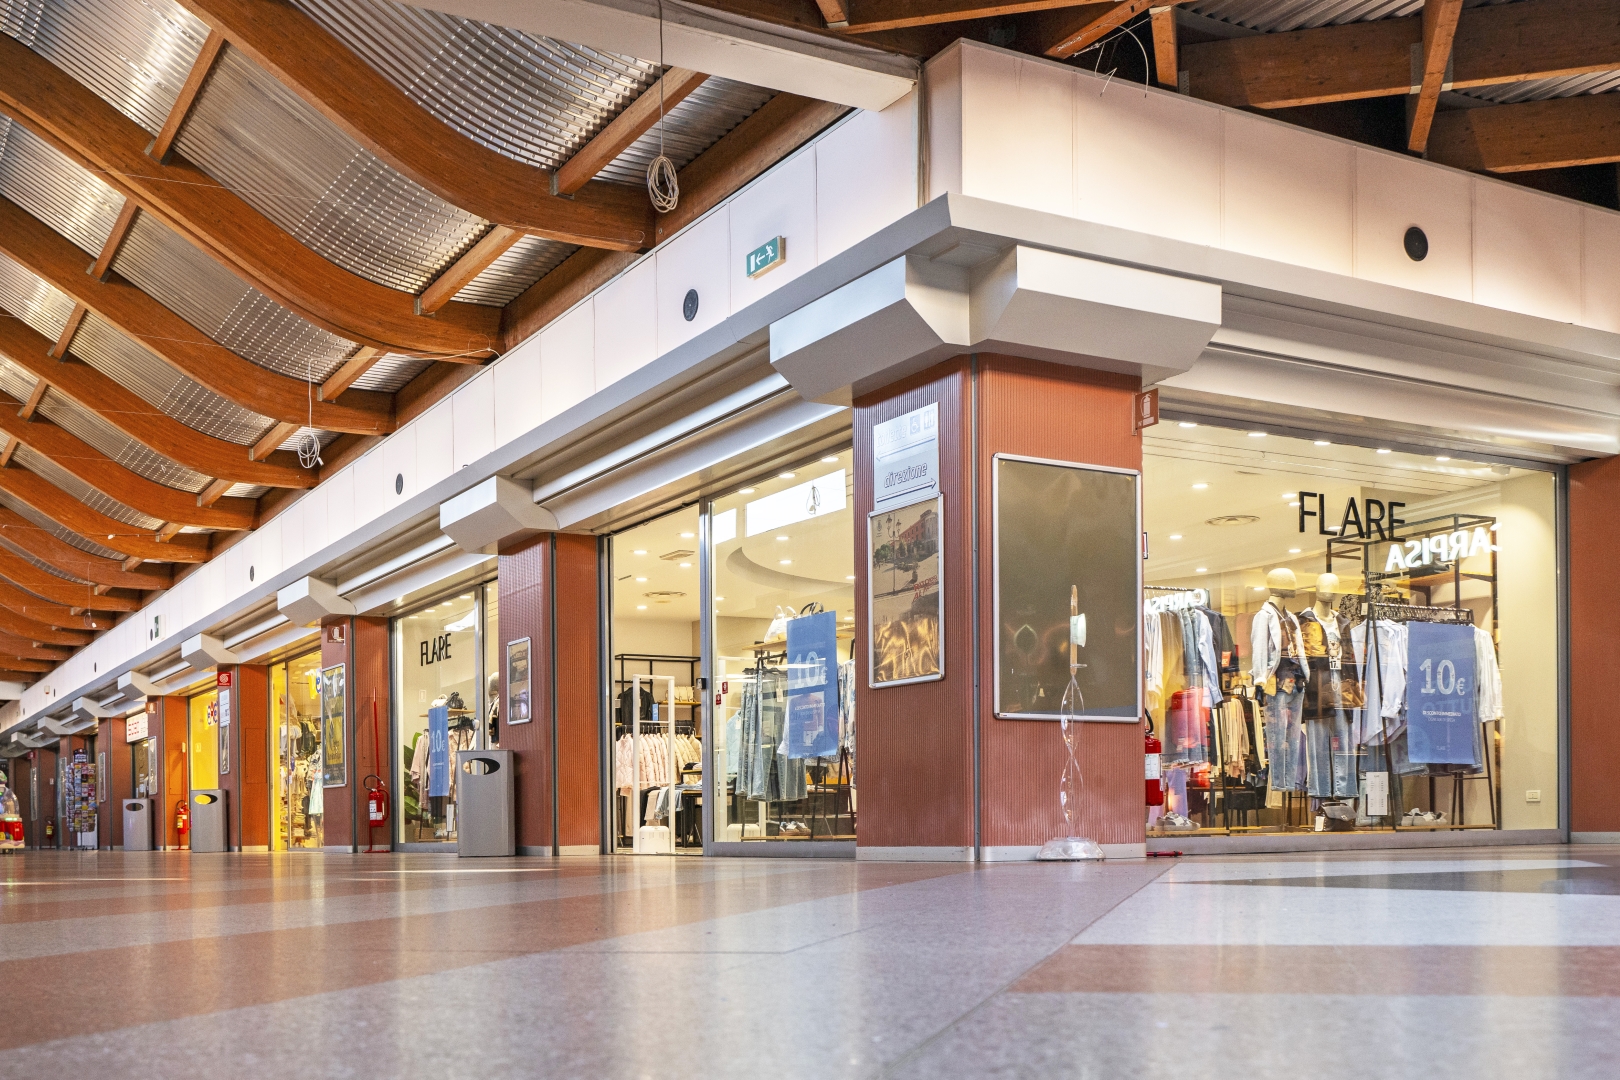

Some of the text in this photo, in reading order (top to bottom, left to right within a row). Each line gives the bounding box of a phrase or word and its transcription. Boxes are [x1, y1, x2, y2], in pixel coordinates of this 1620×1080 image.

[884, 463, 928, 489] direzione
[1299, 491, 1406, 542] FLARE
[420, 633, 452, 667] FLARE
[793, 651, 828, 689] 10€
[1419, 658, 1466, 696] 10€
[431, 729, 446, 753] 10€
